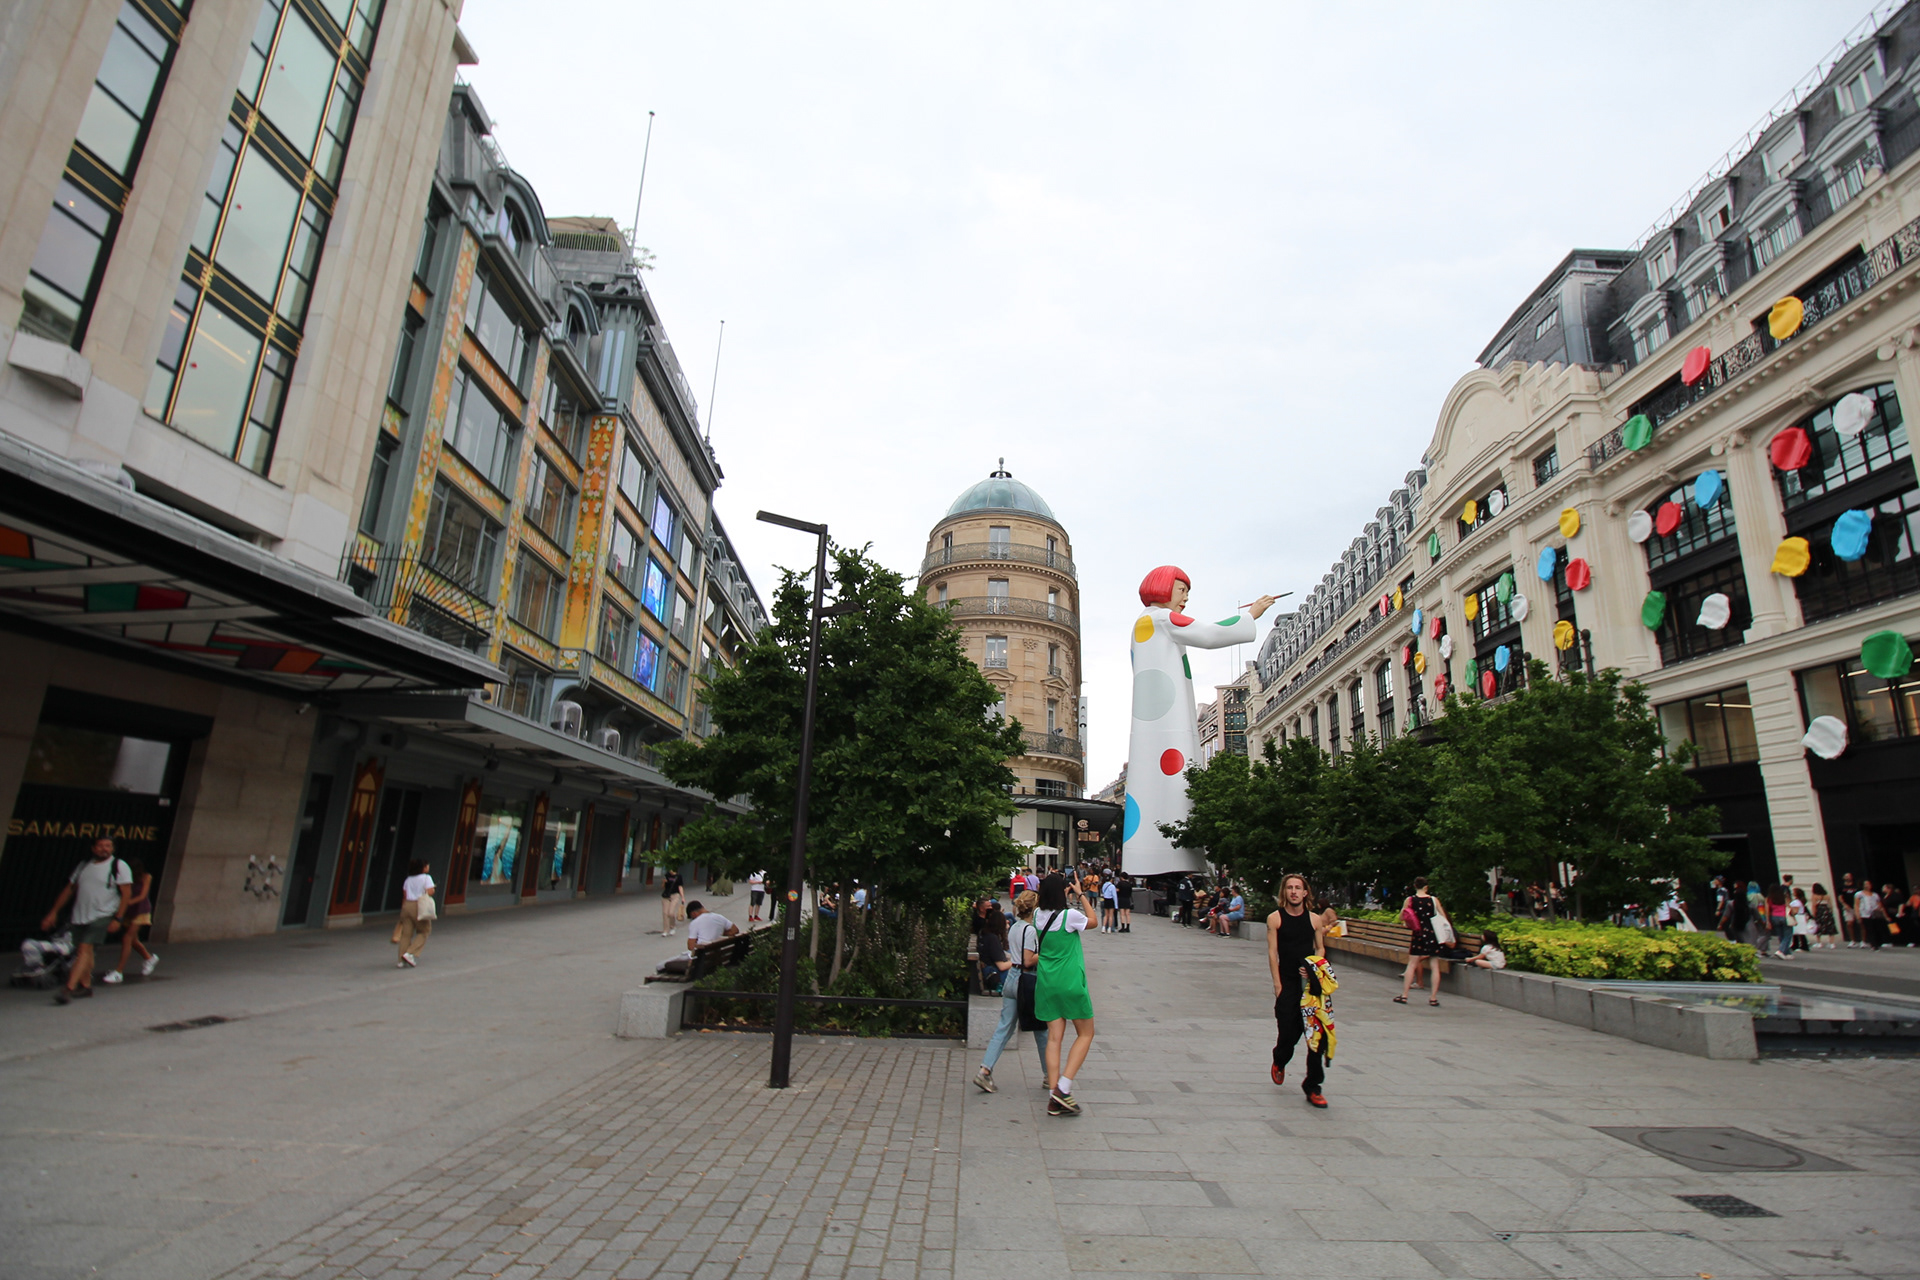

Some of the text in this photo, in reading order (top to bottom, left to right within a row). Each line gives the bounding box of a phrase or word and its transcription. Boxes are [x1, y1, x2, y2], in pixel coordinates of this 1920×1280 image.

[474, 350, 509, 399] BLANC
[527, 529, 559, 564] UNIFORME
[8, 819, 158, 840] SAMARITAINE
